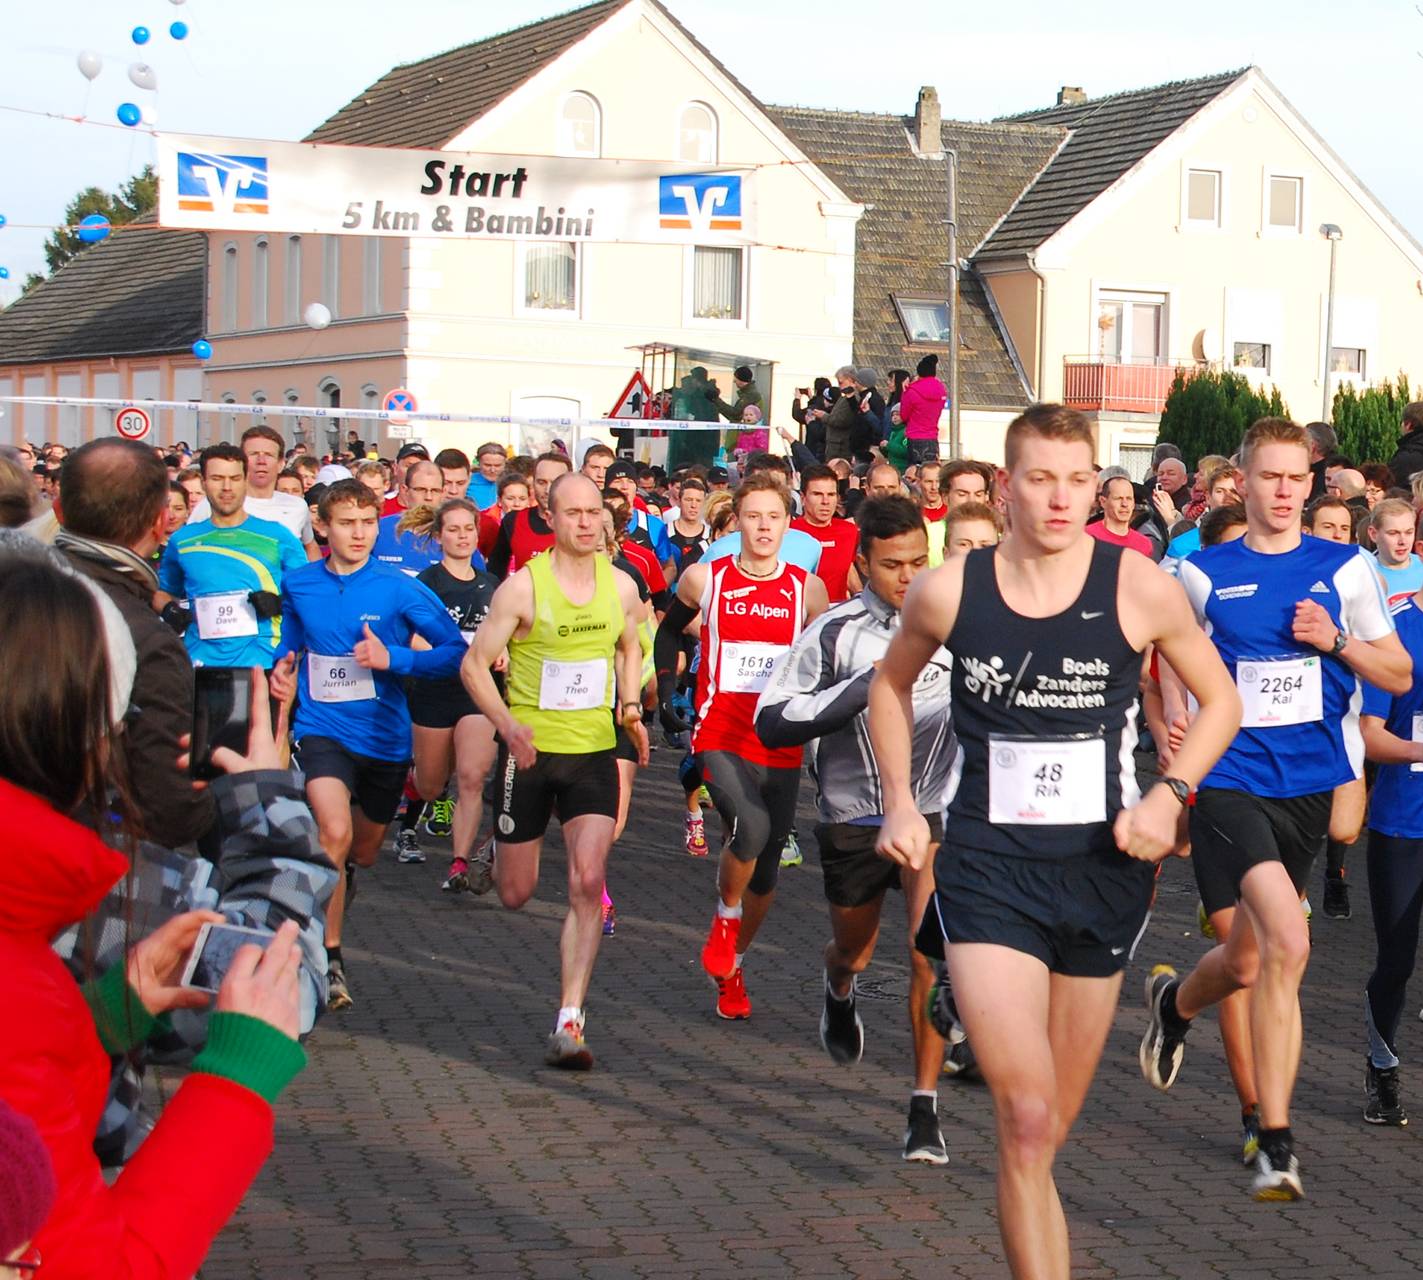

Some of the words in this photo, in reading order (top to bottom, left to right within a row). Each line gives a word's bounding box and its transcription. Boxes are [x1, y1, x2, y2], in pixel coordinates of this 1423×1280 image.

[420, 159, 528, 198] Start
[342, 202, 363, 229] 5
[372, 200, 420, 231] km
[431, 205, 454, 233] &
[465, 206, 595, 236] Bambini
[123, 416, 143, 431] 30
[218, 605, 234, 617] 99
[725, 601, 747, 615] LG
[750, 603, 790, 619] Alpen
[215, 617, 238, 625] Dave
[739, 656, 775, 669] 1618
[1062, 657, 1111, 677] Boels
[329, 668, 347, 680] 66
[573, 673, 583, 686] 3
[322, 679, 358, 688] Jurrian
[565, 686, 589, 695] Theo
[1036, 675, 1108, 693] Zanders
[1260, 674, 1304, 694] 2264
[1014, 689, 1106, 709] Advocaten
[1271, 693, 1293, 705] Kai
[1034, 763, 1063, 782] 48
[1034, 784, 1061, 798] Rik
